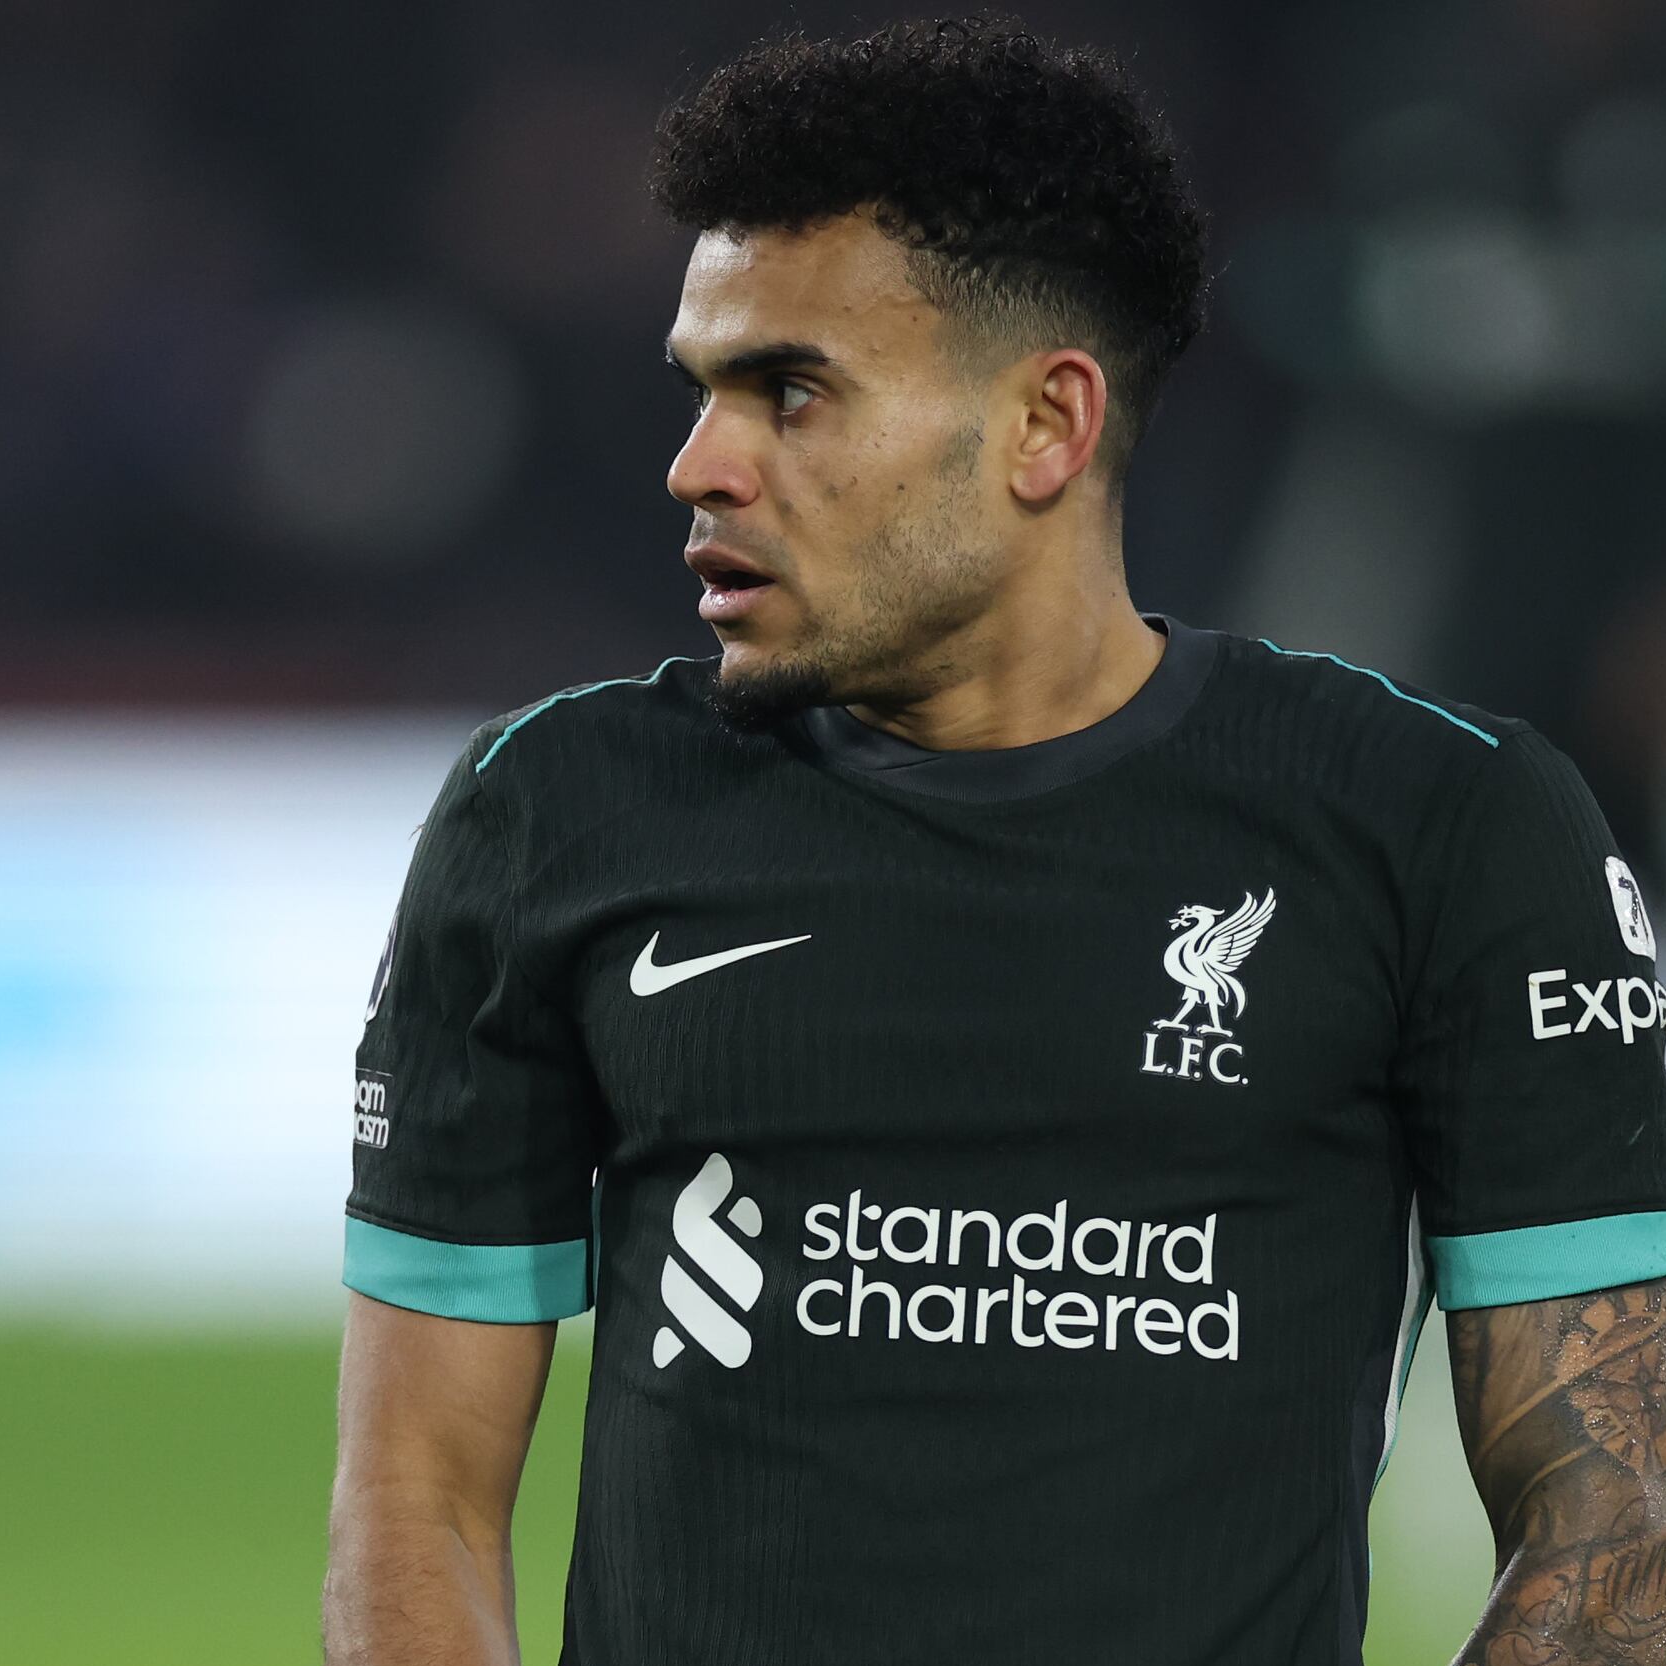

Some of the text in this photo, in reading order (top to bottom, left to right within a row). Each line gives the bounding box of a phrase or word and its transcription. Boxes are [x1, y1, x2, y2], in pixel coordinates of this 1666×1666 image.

[1141, 1032, 1249, 1085] L.F.C.
[802, 1188, 1217, 1286] standard
[796, 1264, 1239, 1362] chartered
